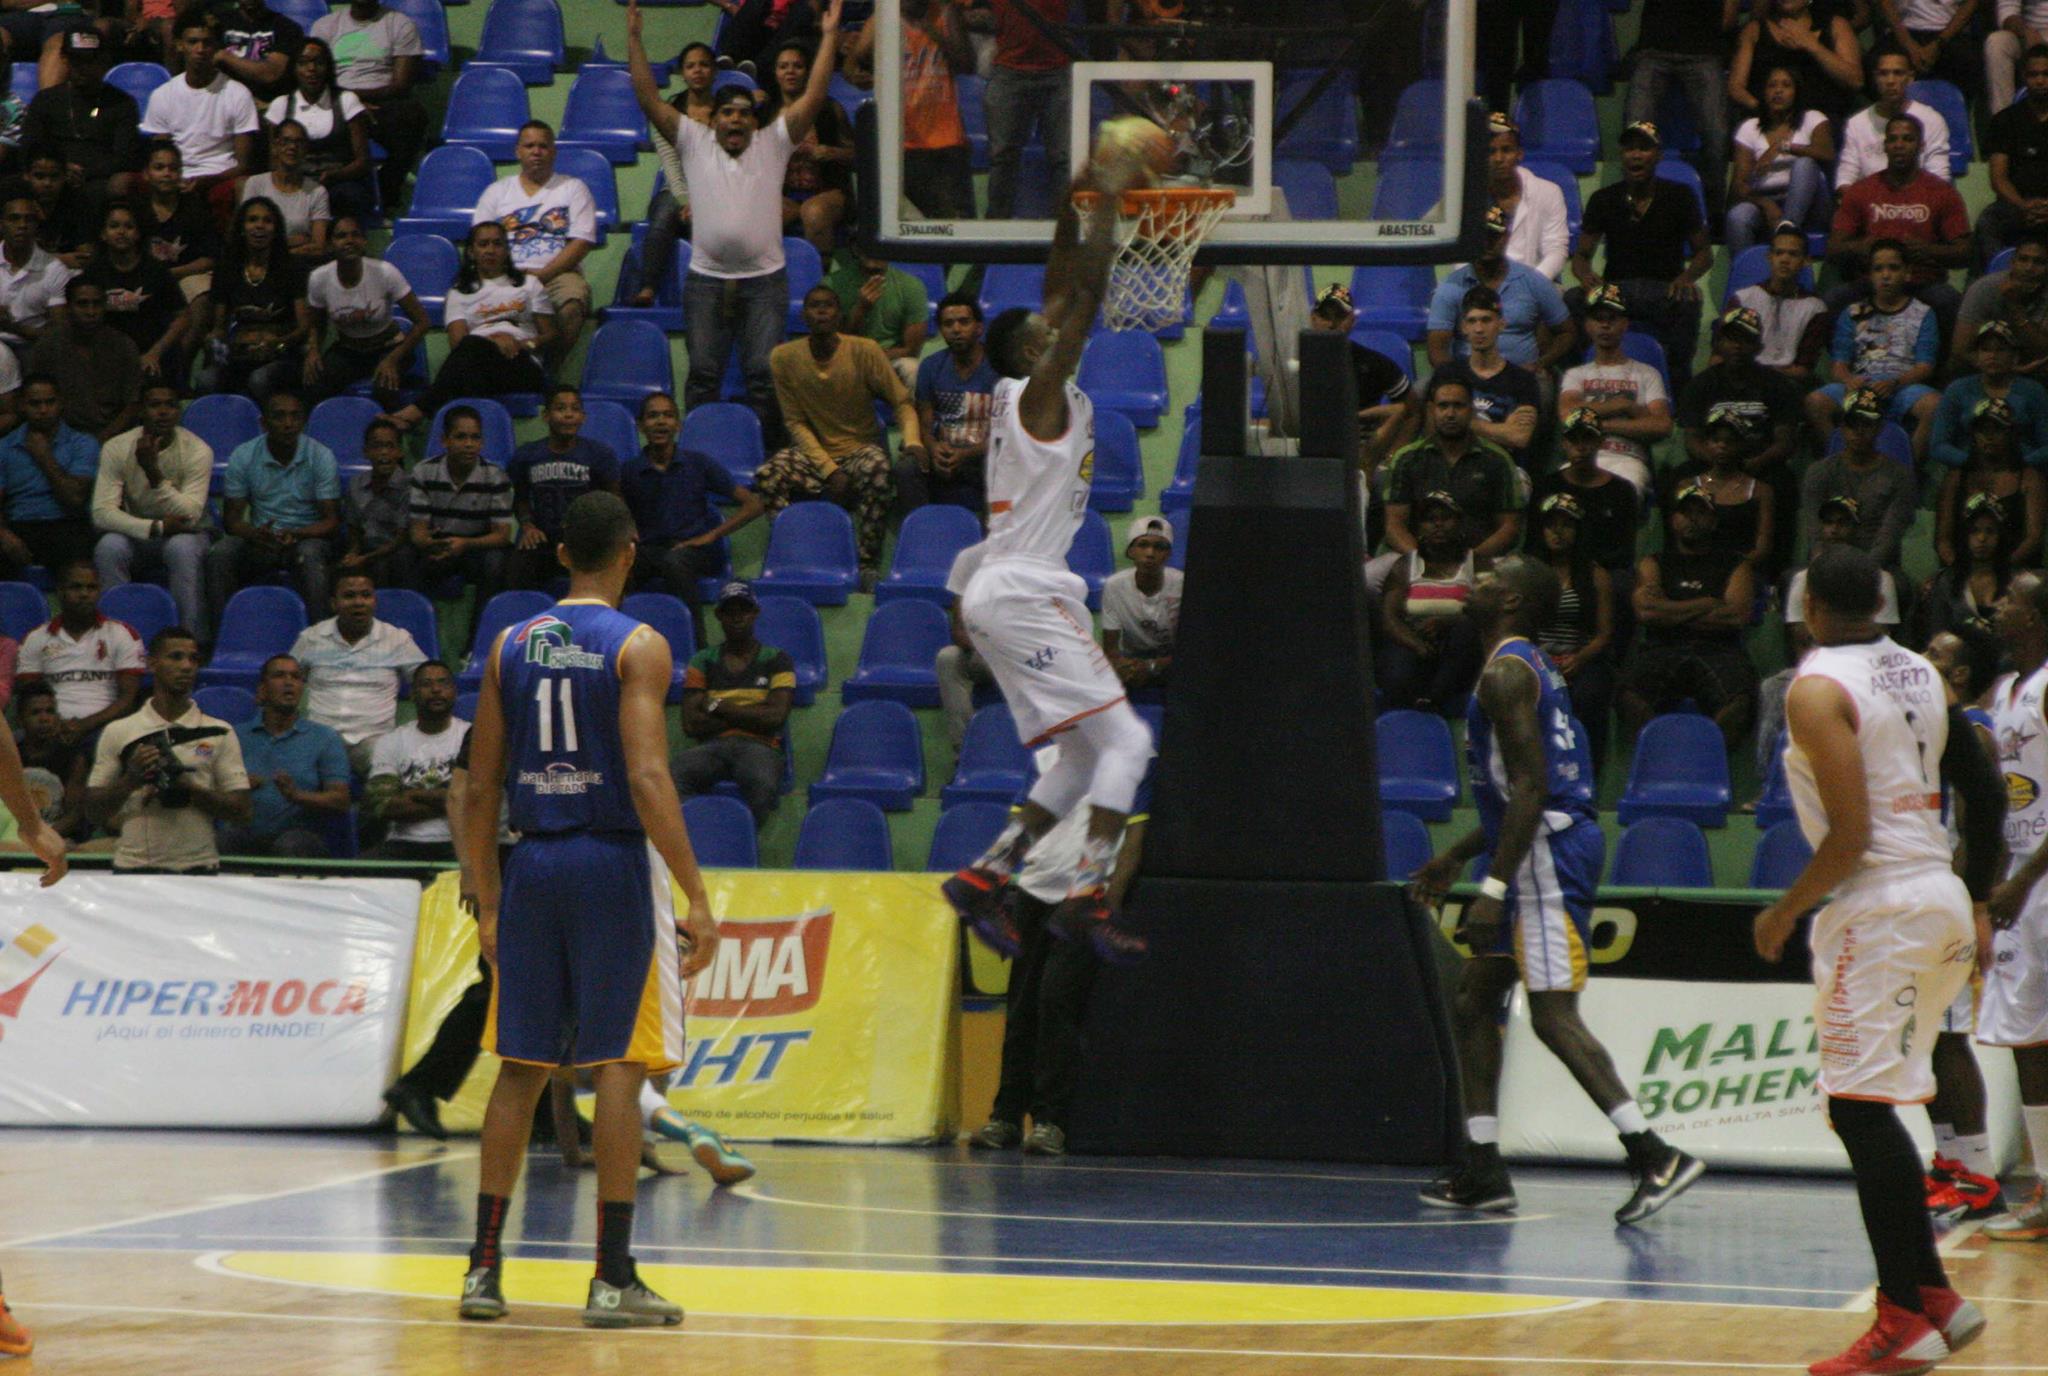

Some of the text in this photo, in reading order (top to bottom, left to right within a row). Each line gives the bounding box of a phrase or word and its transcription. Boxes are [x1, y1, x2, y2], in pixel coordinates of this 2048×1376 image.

[1871, 203, 1929, 223] Norton
[899, 223, 954, 236] SPALDING
[1378, 224, 1436, 236] ABASTESA
[530, 461, 591, 483] BROOKLYN
[535, 677, 579, 752] 11
[62, 979, 368, 1017] HIPER MOCA
[179, 1023, 242, 1039] dinero
[249, 1021, 326, 1039] RINDE!
[715, 1108, 732, 1119] de
[736, 1108, 780, 1120] alcohol
[1692, 1118, 1714, 1130] DE
[1718, 1110, 1772, 1126] MALTA
[1778, 1105, 1805, 1118] SIN
